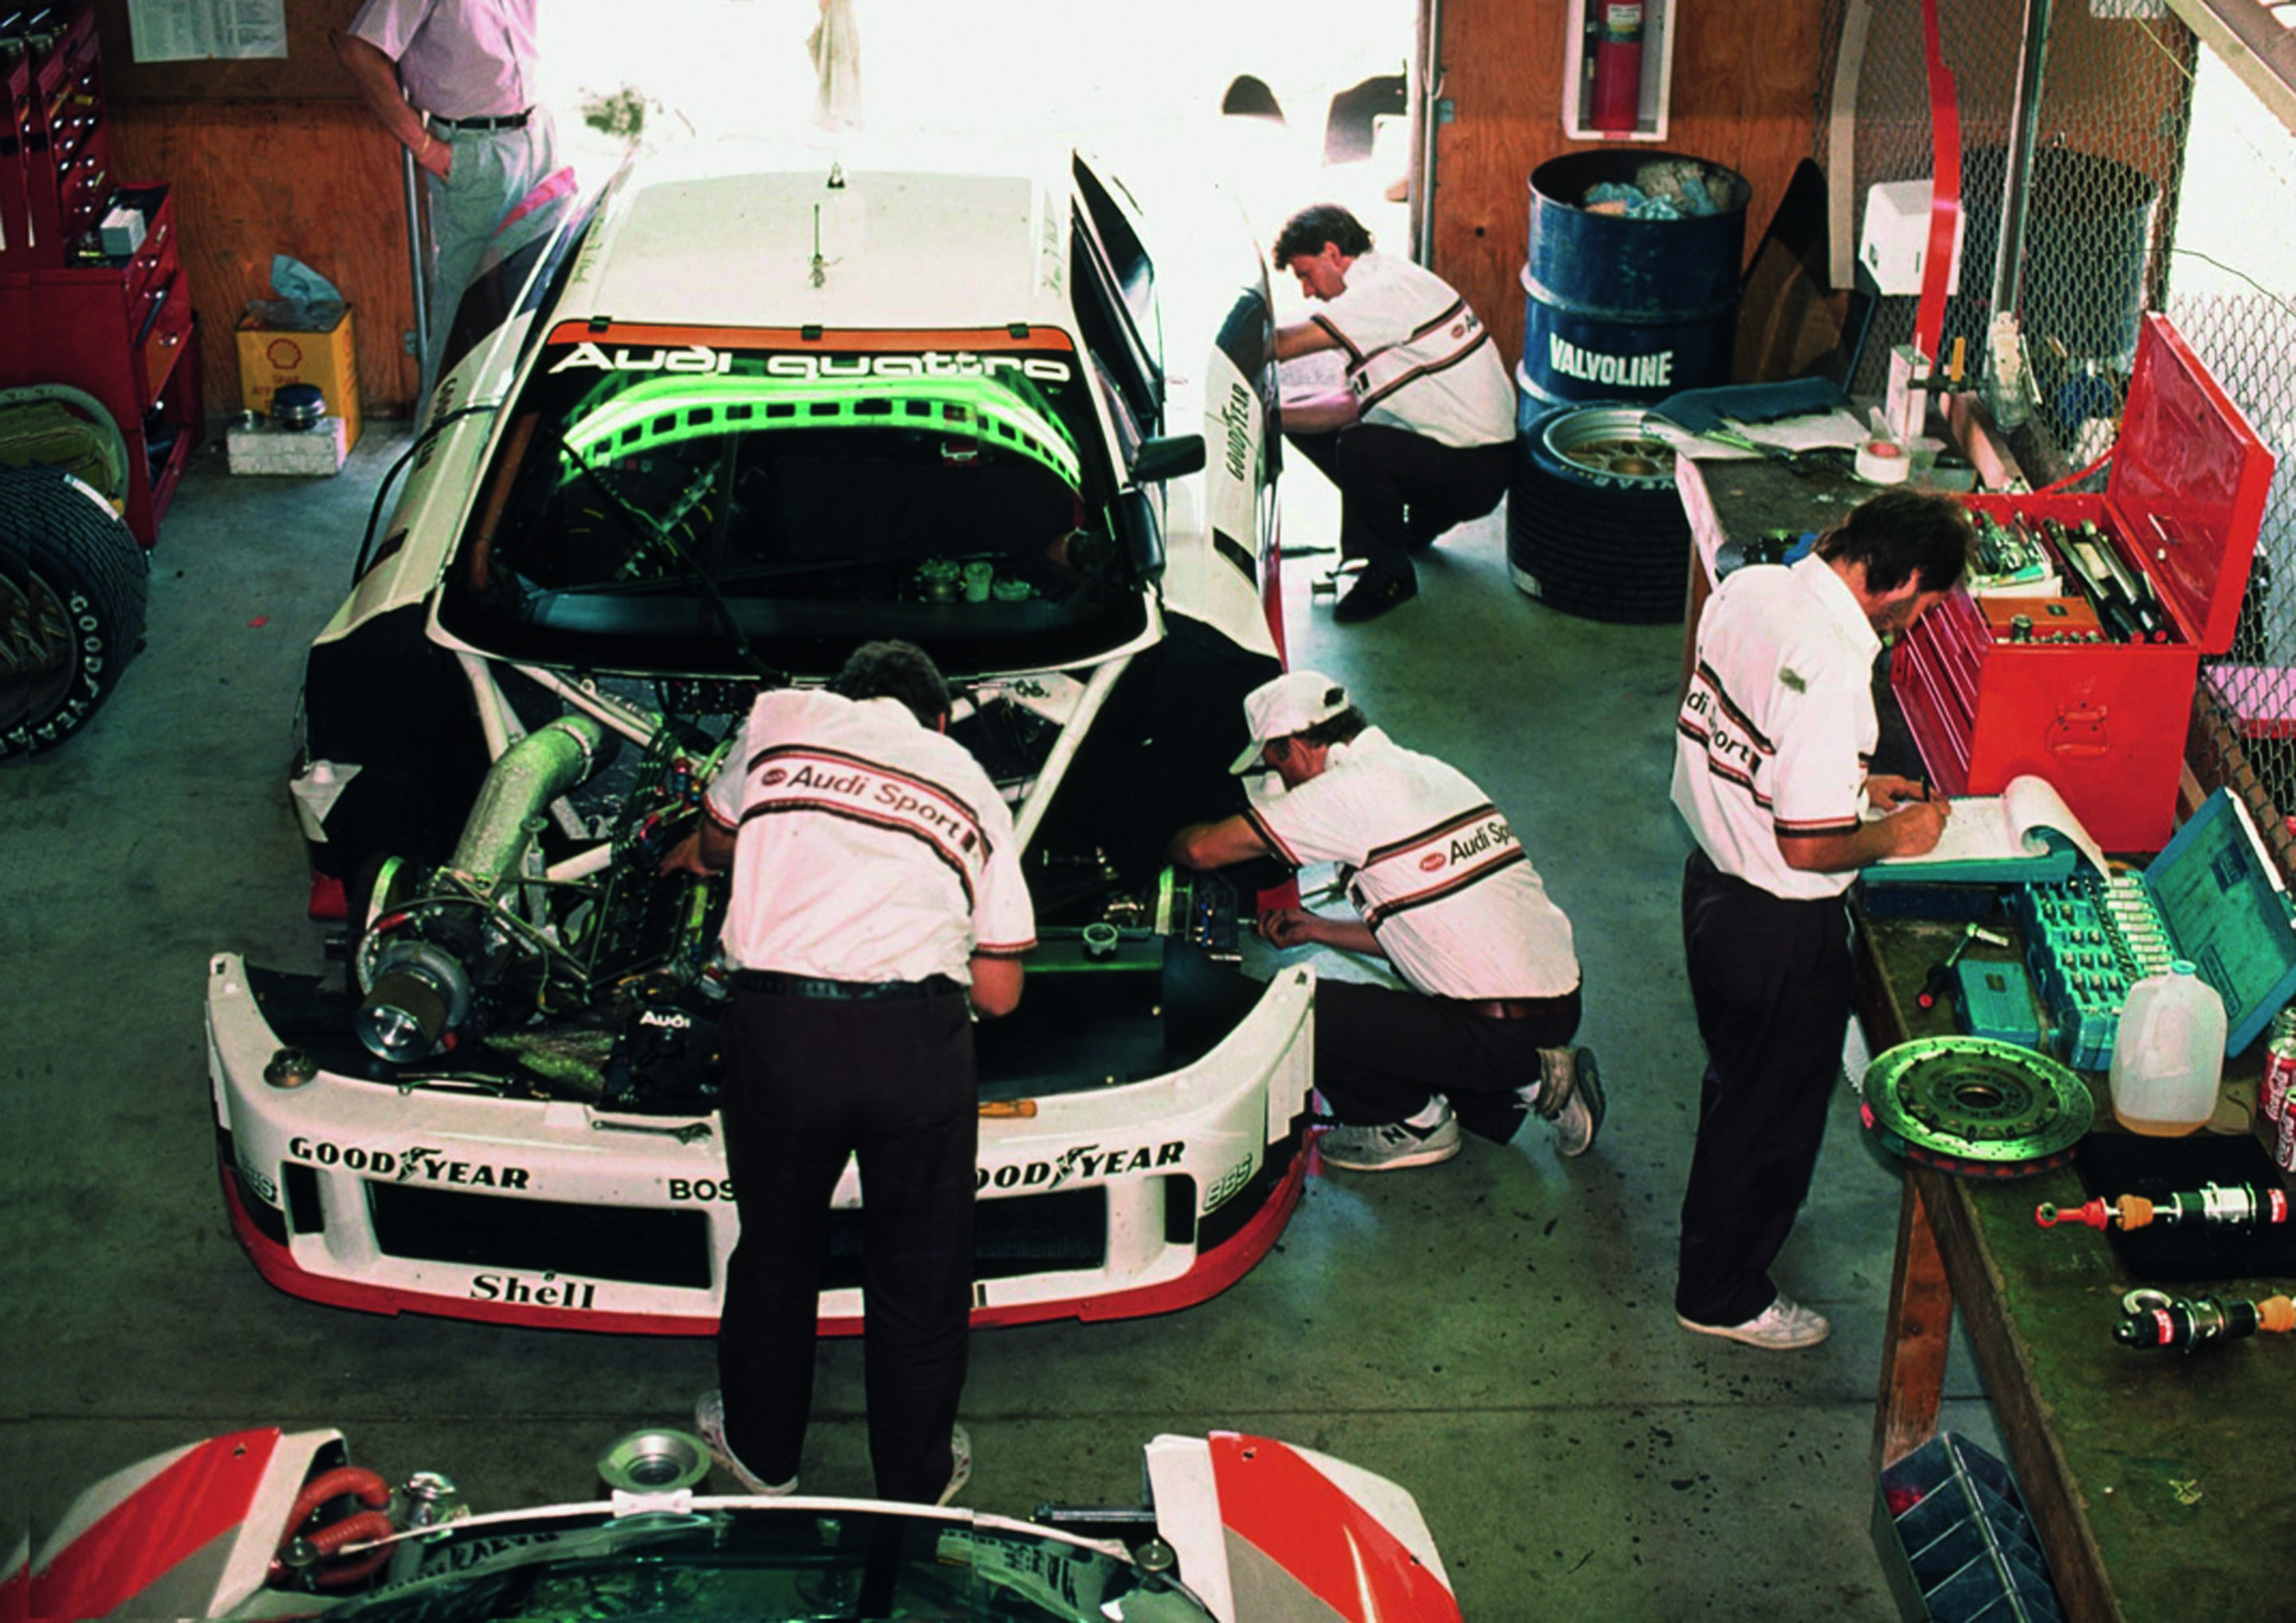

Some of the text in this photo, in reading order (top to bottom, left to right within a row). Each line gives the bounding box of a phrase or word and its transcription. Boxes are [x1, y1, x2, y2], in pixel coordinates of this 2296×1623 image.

[548, 341, 1071, 382] Audi quattro
[1550, 331, 1673, 387] VALVOLINE
[786, 765, 870, 796] Audi
[873, 782, 961, 839] Sport
[1450, 827, 1491, 866] Audi
[470, 1273, 596, 1309] Shell
